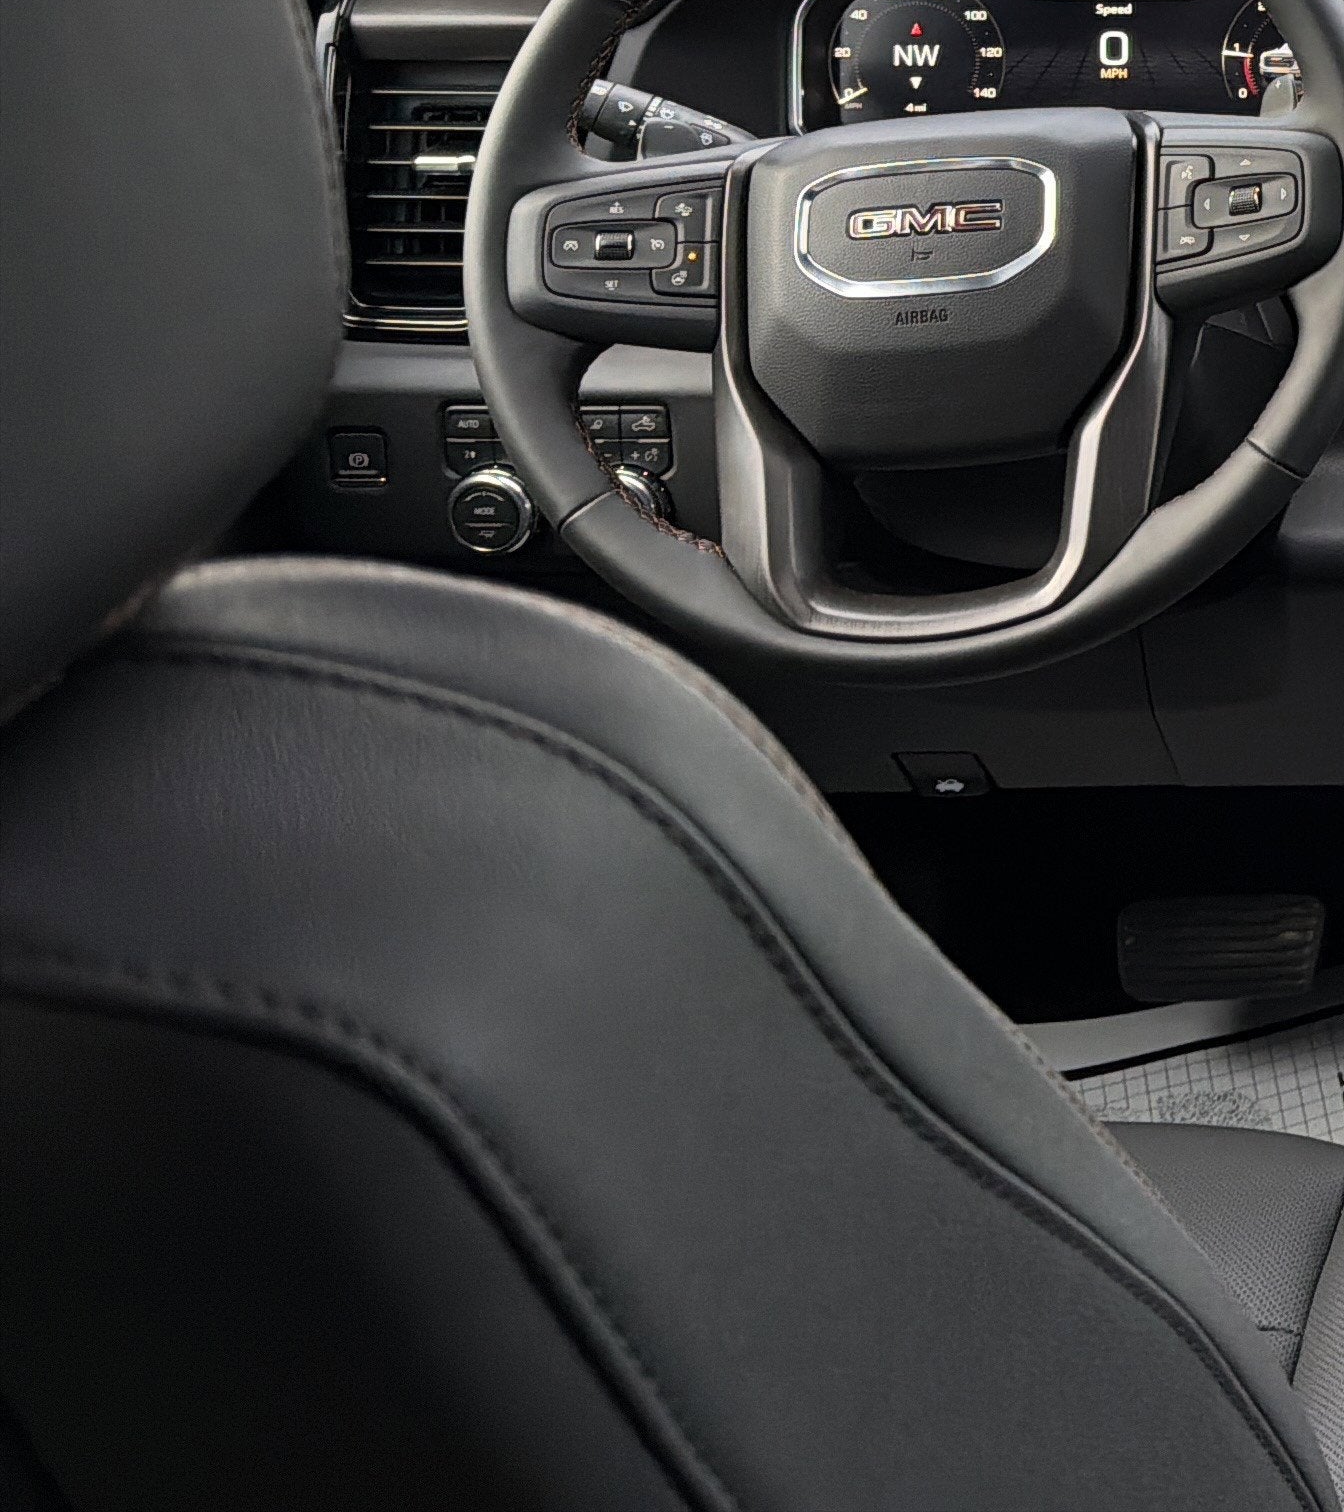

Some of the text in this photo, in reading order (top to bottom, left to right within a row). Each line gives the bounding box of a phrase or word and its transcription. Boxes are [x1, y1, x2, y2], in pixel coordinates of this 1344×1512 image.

[850, 9, 868, 20] 40
[964, 10, 988, 21] 100
[1095, 3, 1132, 17] Speed
[834, 47, 851, 58] 20
[979, 47, 1003, 58] 120
[1099, 31, 1129, 65] 0
[893, 44, 940, 67] NW
[1100, 68, 1128, 79] MPH
[973, 88, 997, 98] 140
[1238, 88, 1248, 99] 0
[847, 200, 1004, 239] GMC
[604, 279, 619, 288] SET
[895, 307, 949, 327] AIRBAG
[457, 418, 480, 430] AUTO
[473, 505, 496, 516] MODE
